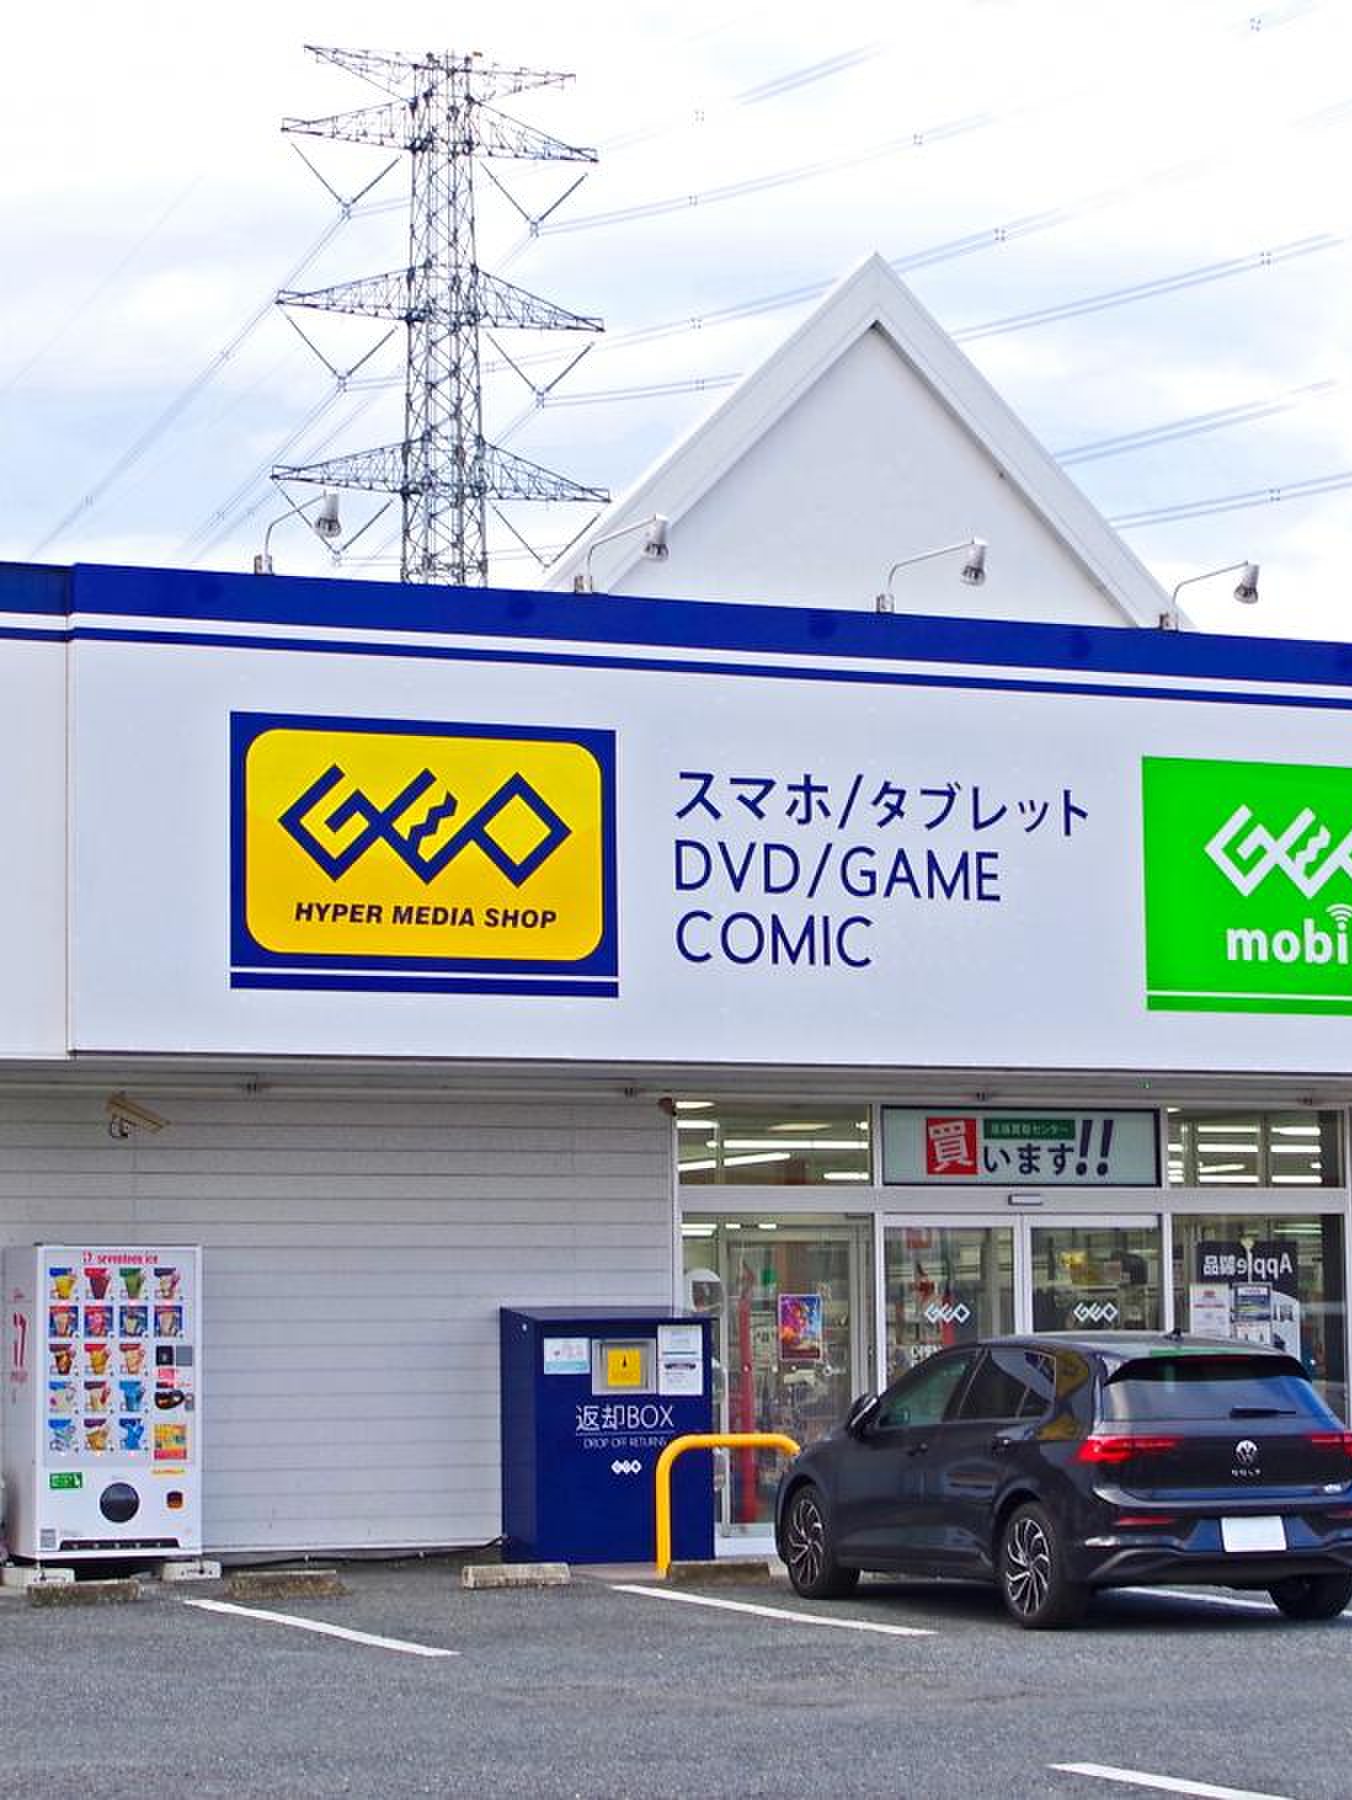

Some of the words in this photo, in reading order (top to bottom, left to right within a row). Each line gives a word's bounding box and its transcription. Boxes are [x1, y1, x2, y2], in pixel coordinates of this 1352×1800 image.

[277, 763, 572, 888] GEO
[674, 771, 1089, 836] スマホ/タブレット
[674, 839, 1001, 902] DVD/GAME
[295, 901, 383, 925] HYPER
[391, 904, 476, 927] MEDIA
[484, 907, 557, 929] SHOP
[675, 910, 873, 967] COMIC
[576, 1403, 674, 1431] 返却BOX
